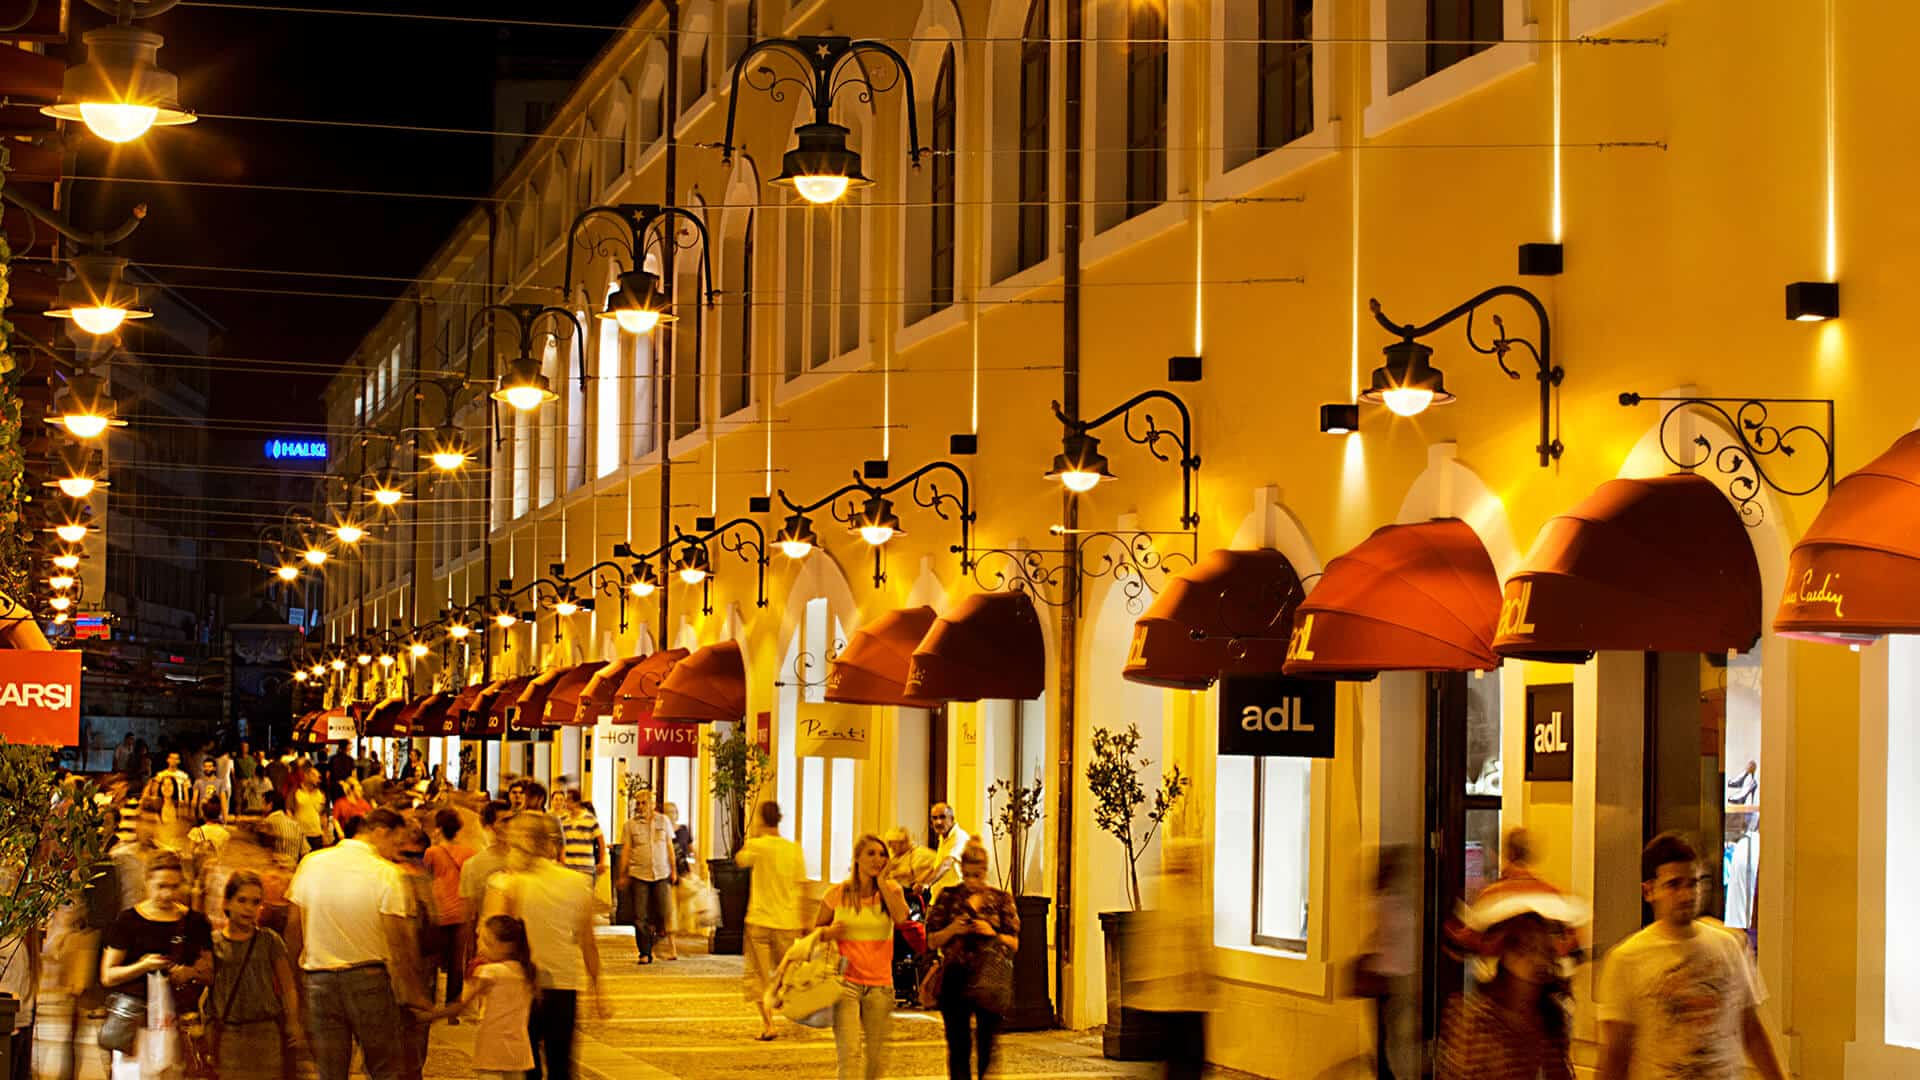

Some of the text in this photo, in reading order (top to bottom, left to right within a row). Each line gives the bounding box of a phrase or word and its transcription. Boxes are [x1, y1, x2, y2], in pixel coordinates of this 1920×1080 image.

[1496, 582, 1536, 640] adL
[0, 682, 73, 711] ARŞI
[800, 718, 865, 742] Penti
[1241, 696, 1315, 732] adL
[600, 730, 636, 745] HOT
[1534, 711, 1568, 754] adL
